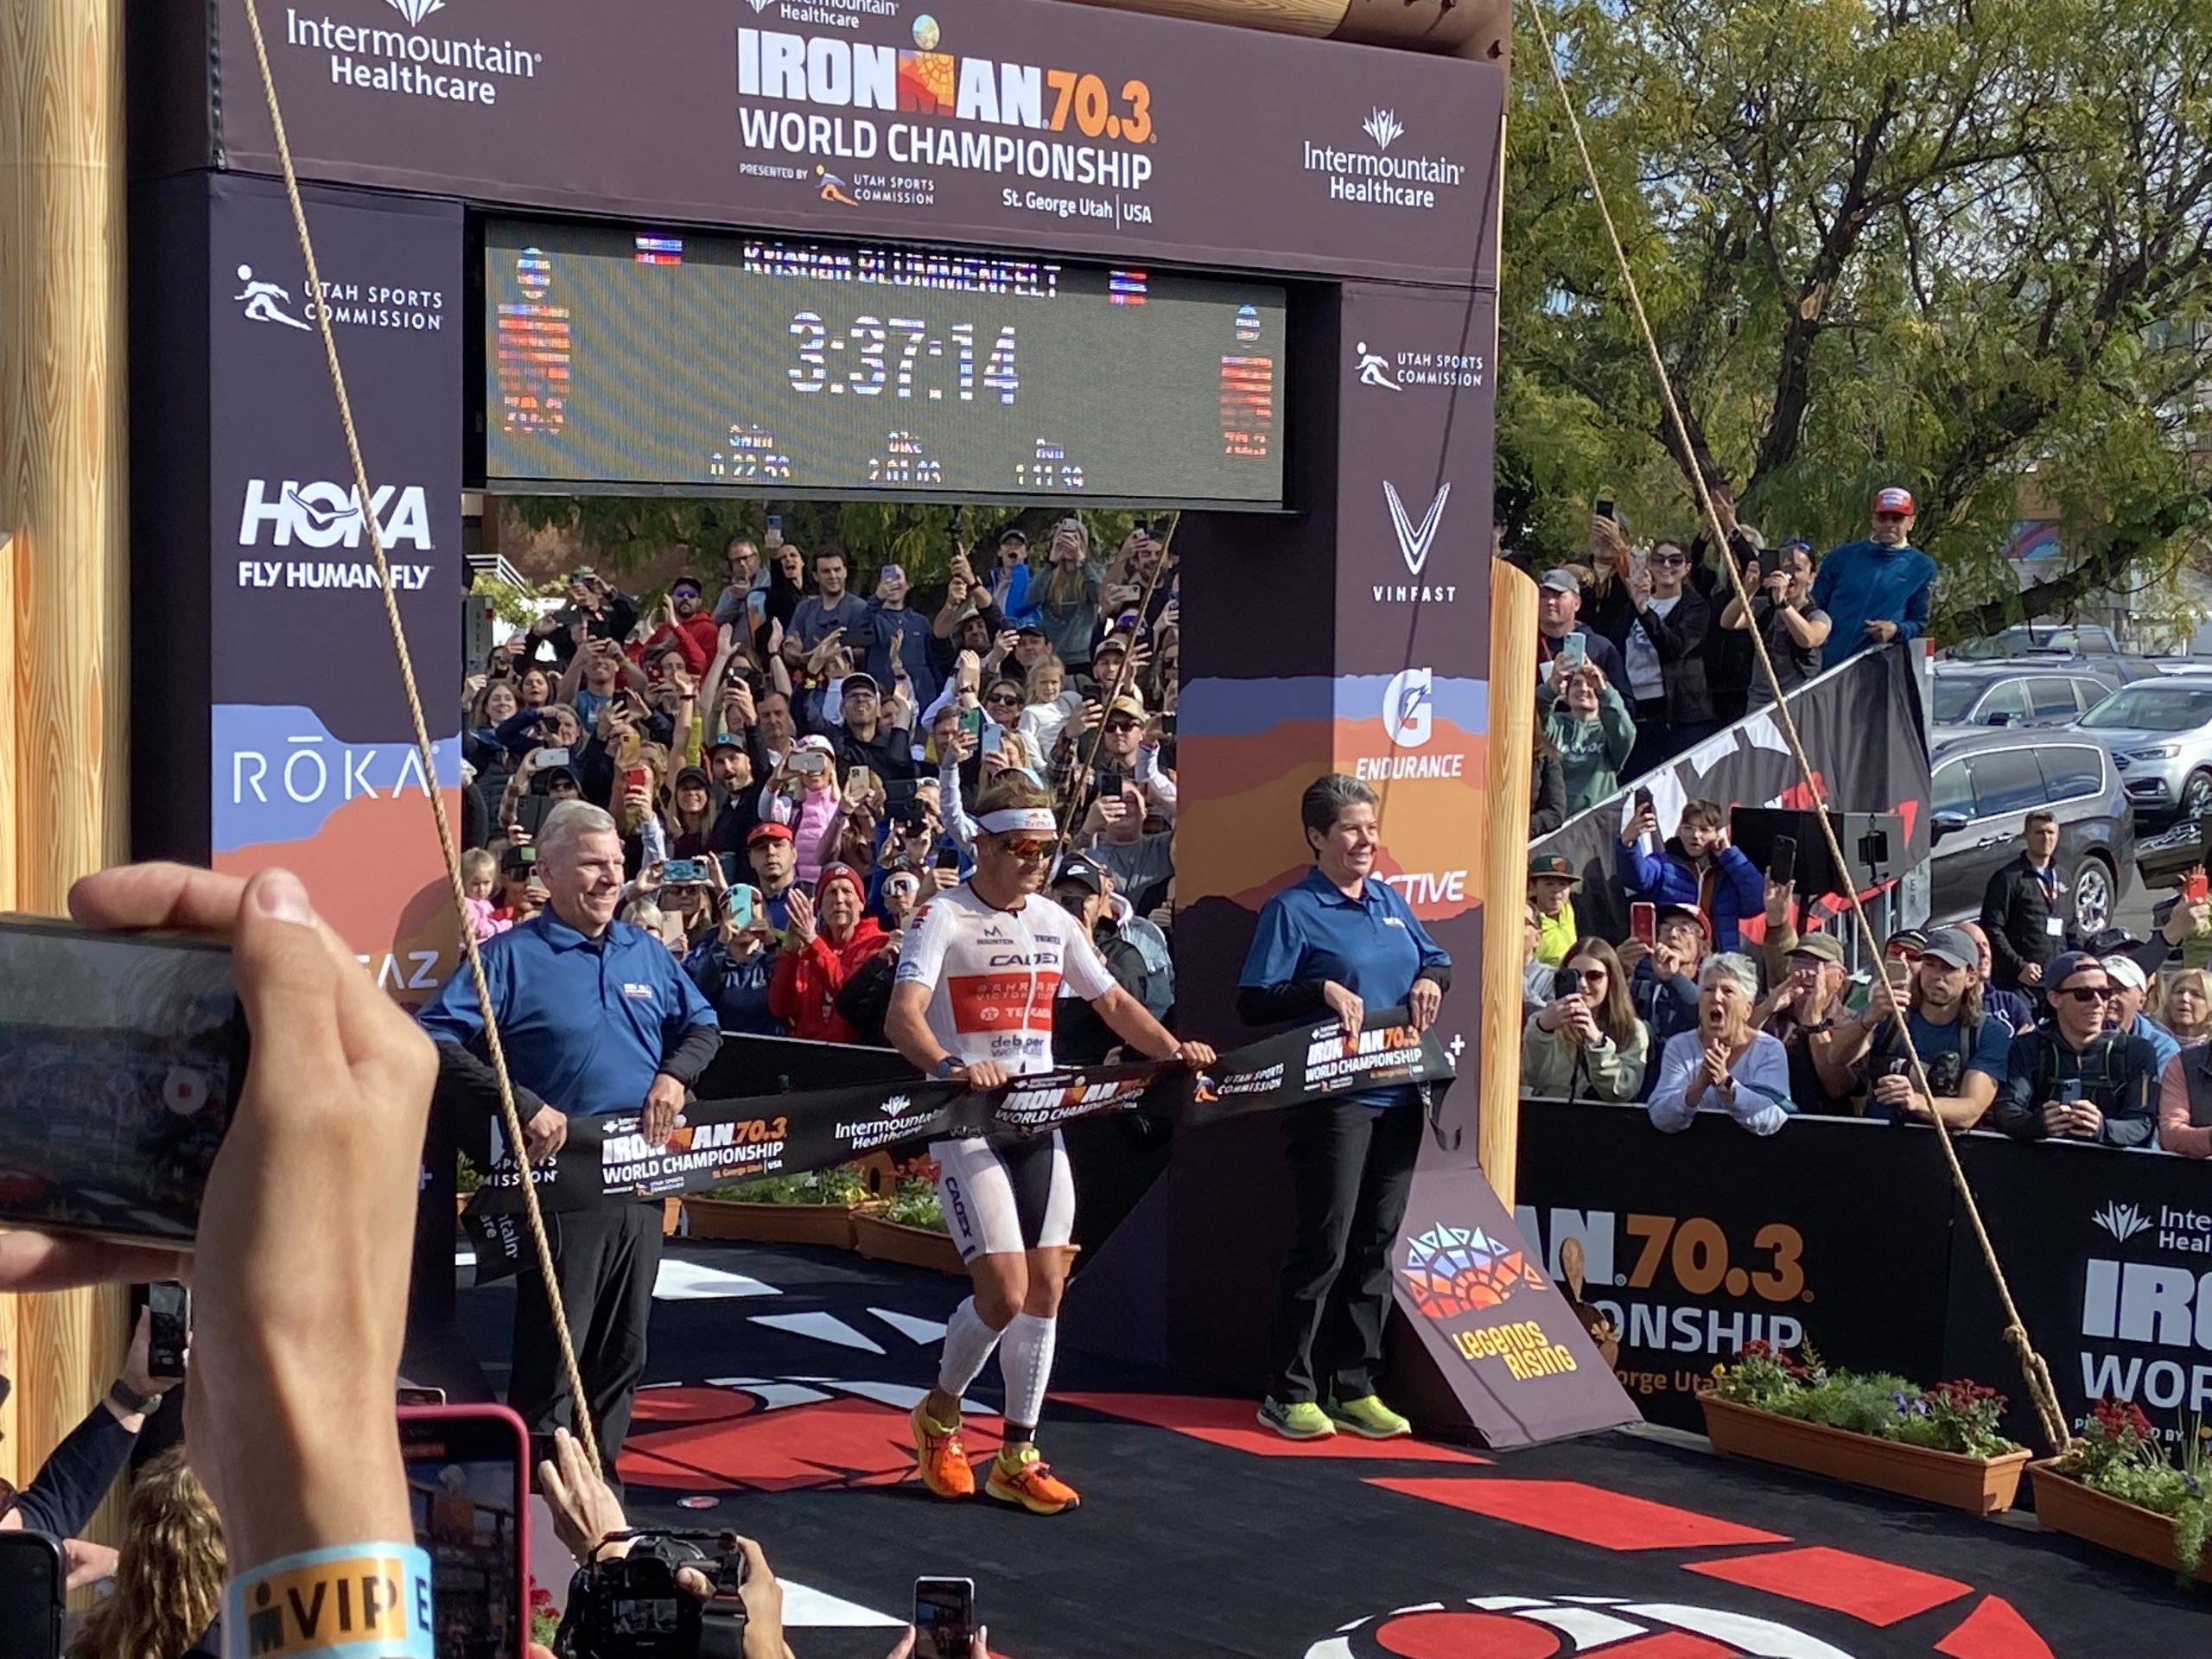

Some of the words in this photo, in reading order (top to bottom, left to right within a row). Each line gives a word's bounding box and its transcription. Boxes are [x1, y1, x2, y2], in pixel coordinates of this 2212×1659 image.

[780, 3, 860, 29] Healthcare
[286, 9, 535, 77] Intermountain
[331, 55, 497, 105] Healthcare
[1046, 69, 1152, 144] 70.3
[738, 107, 878, 160] WORLD
[887, 124, 1153, 190] CHAMPIONSHIP
[1303, 140, 1459, 185] Intermountain
[739, 162, 794, 180] PRESENTED
[796, 168, 809, 181] BY
[853, 174, 886, 188] UTAH
[889, 176, 935, 191] SPORTS
[854, 188, 934, 206] COMMISSION
[1002, 188, 1022, 207] St.
[1025, 190, 1077, 219] George
[1079, 197, 1113, 219] Utah
[1123, 203, 1153, 224] USA
[1330, 175, 1434, 208] Healthcare
[304, 280, 359, 302] UTAH
[368, 286, 442, 309] SPORTS
[304, 302, 441, 330] COMMISSION
[788, 311, 1019, 405] 3:37:14
[1396, 352, 1432, 368] UTAH
[1436, 353, 1484, 370] SPORTS
[1396, 368, 1483, 386] COMMISSION
[238, 479, 432, 550] HOKA
[238, 561, 283, 588] FLY
[286, 562, 384, 589] HUMAN
[390, 564, 431, 590] FLY
[1372, 585, 1457, 602] VINFAST
[1355, 753, 1465, 781] ENDURANCE
[1305, 1062, 1338, 1083] WORLD
[1338, 1047, 1422, 1075] CHAMPIONSHIP
[995, 1108, 1050, 1124] WORLD
[603, 1161, 658, 1184] WORLD
[662, 1141, 785, 1174] CHAMPIONSHIP
[1626, 1212, 1805, 1303] 70.3
[286, 1575, 398, 1639] VIP
